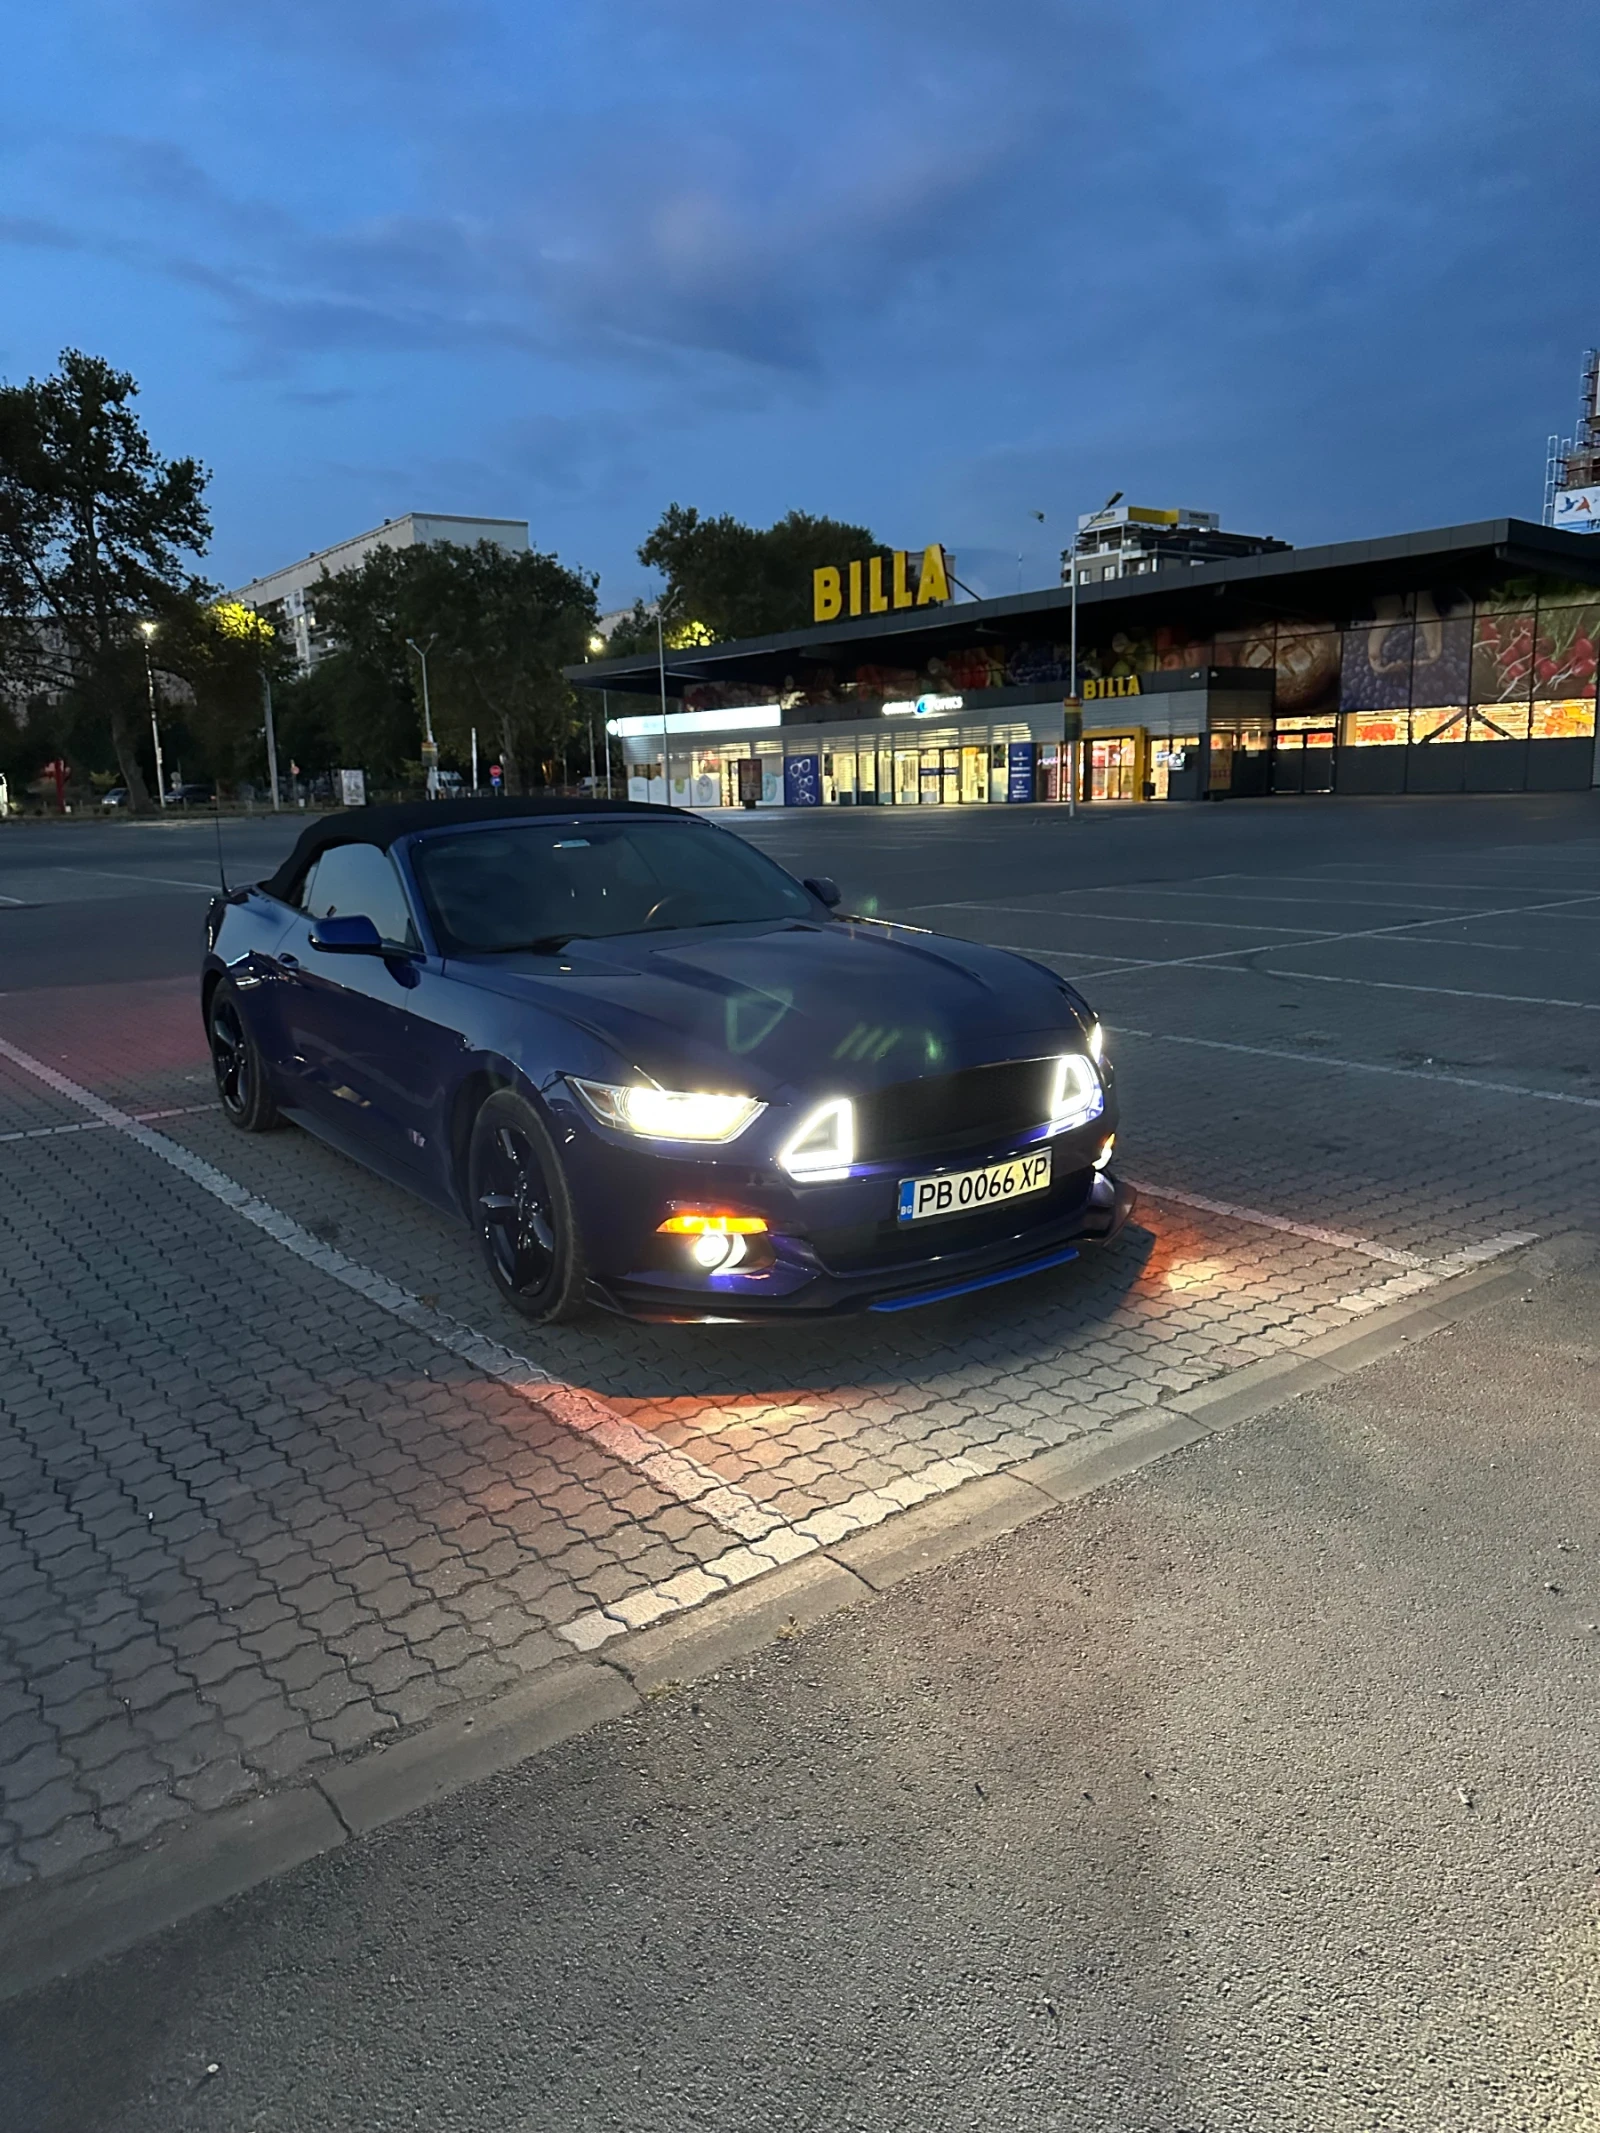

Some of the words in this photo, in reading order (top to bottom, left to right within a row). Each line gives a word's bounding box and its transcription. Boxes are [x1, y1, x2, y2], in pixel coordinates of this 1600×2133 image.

[813, 543, 950, 623] BILLA
[1083, 674, 1141, 700] BILLA
[918, 1181, 953, 1213] PB
[958, 1166, 1015, 1204] 0066
[1019, 1157, 1047, 1190] XP
[900, 1205, 913, 1215] BG
